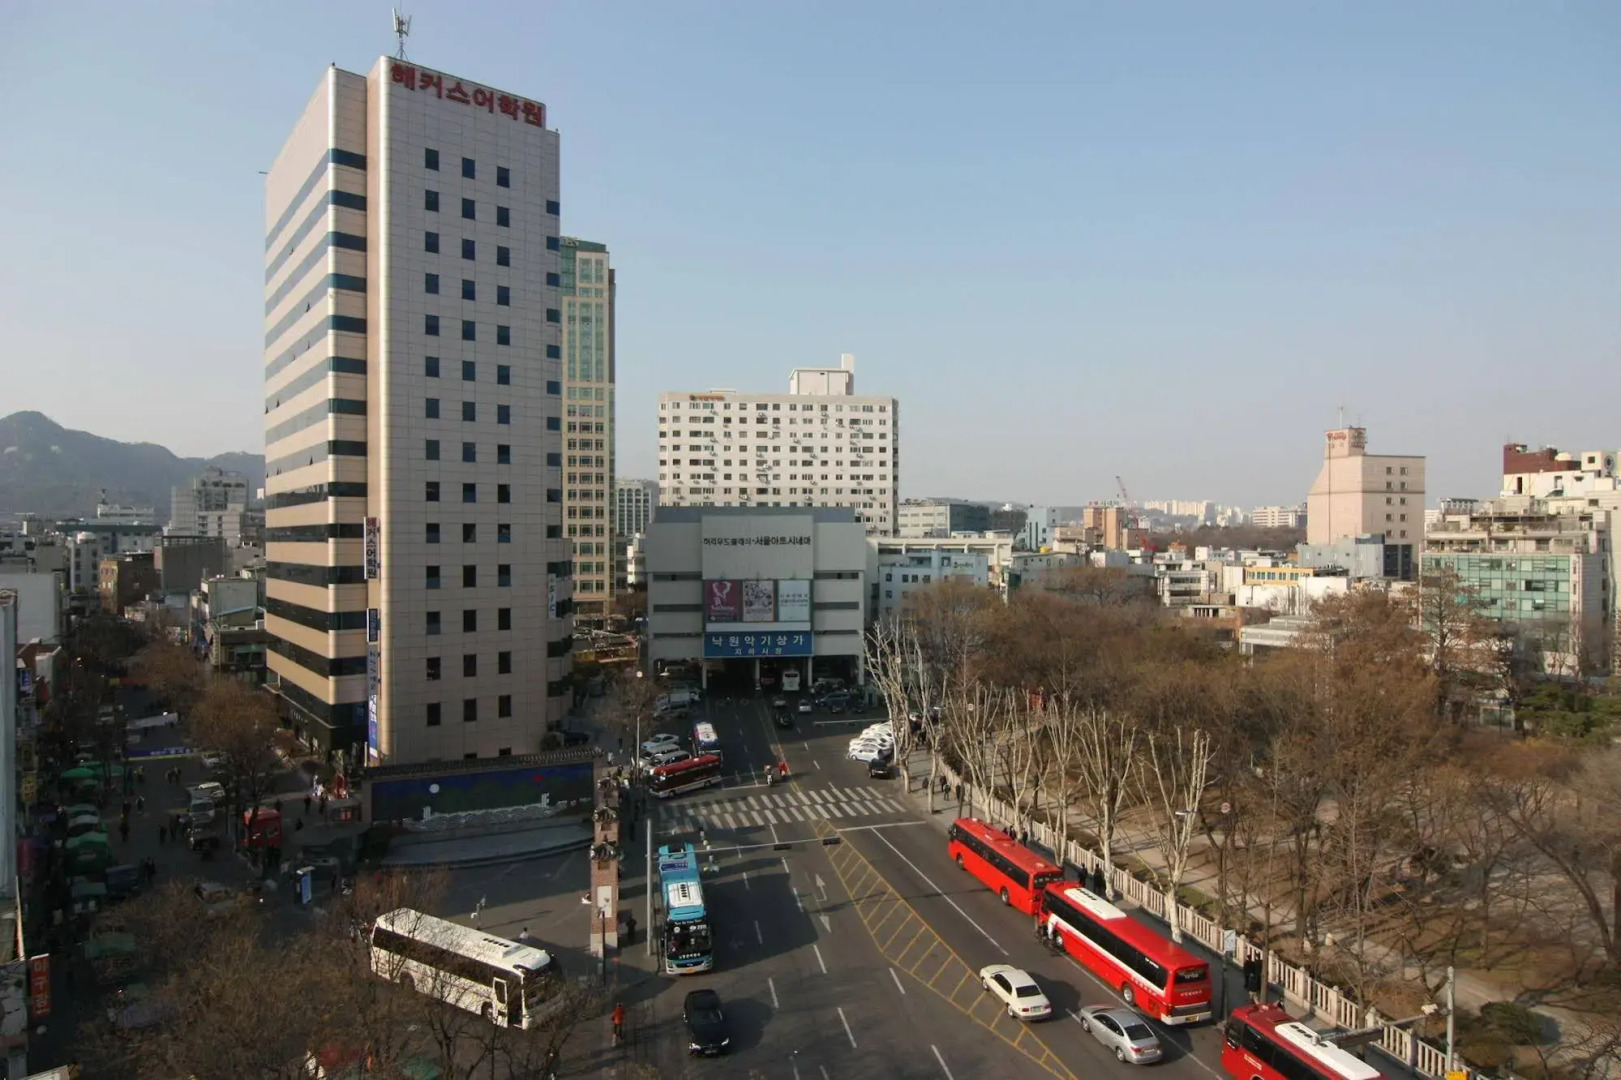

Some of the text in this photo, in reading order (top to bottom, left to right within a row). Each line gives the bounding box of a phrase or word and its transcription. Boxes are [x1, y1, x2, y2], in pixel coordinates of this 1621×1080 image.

[391, 62, 543, 128] 해커스어학원
[366, 517, 378, 579] 해커스어학원
[711, 634, 805, 647] 낙원악기상가
[734, 647, 783, 656] 지하시장
